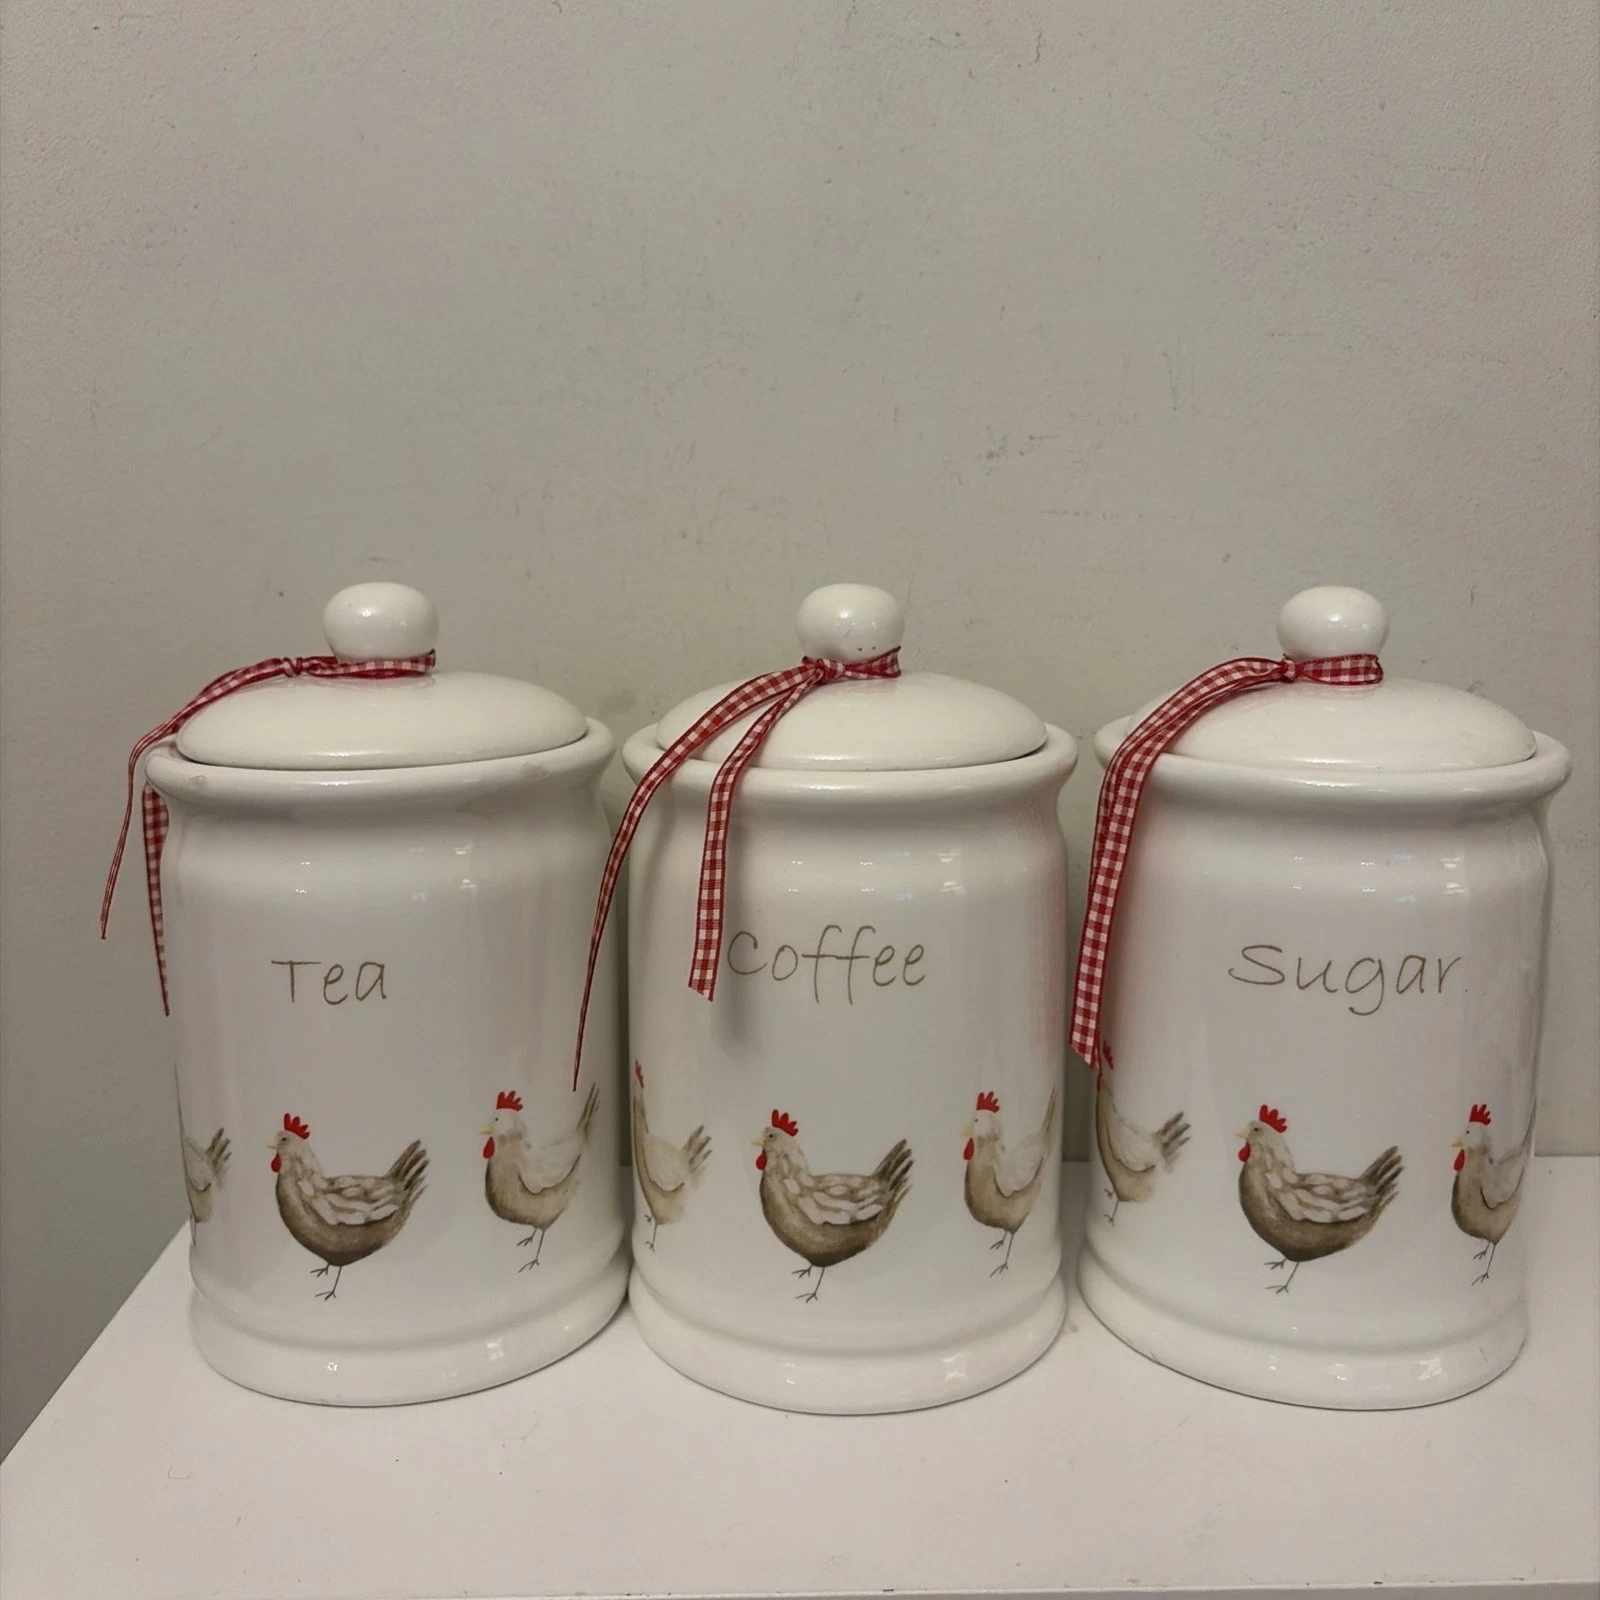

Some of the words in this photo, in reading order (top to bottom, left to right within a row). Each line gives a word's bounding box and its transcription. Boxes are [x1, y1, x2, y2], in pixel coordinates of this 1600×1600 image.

[270, 959, 387, 1006] Tea
[727, 924, 926, 1006] Coffee
[1227, 944, 1463, 1017] Sugar
